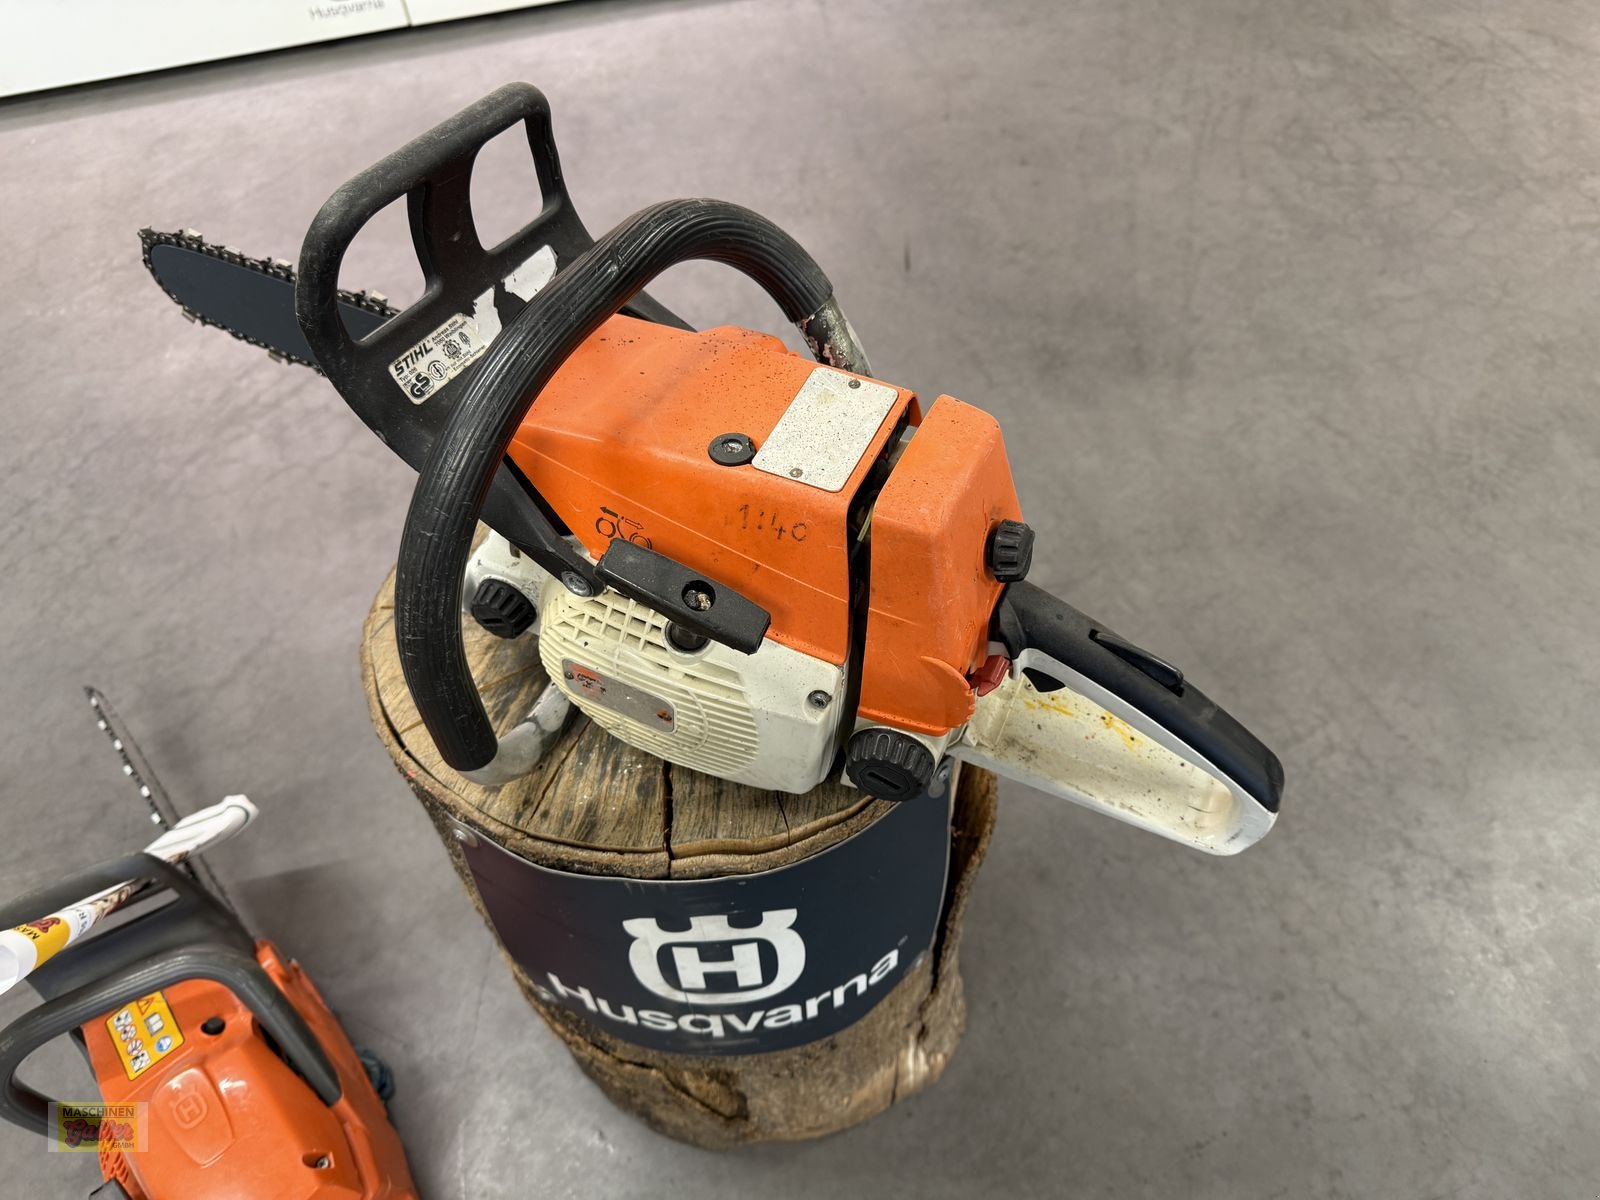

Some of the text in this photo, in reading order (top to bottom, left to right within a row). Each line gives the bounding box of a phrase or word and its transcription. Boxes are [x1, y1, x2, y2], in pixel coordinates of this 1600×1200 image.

[394, 342, 433, 377] STIHL
[410, 374, 431, 399] GS
[739, 503, 808, 542] 1:40
[547, 948, 900, 1038] Husqvarna
